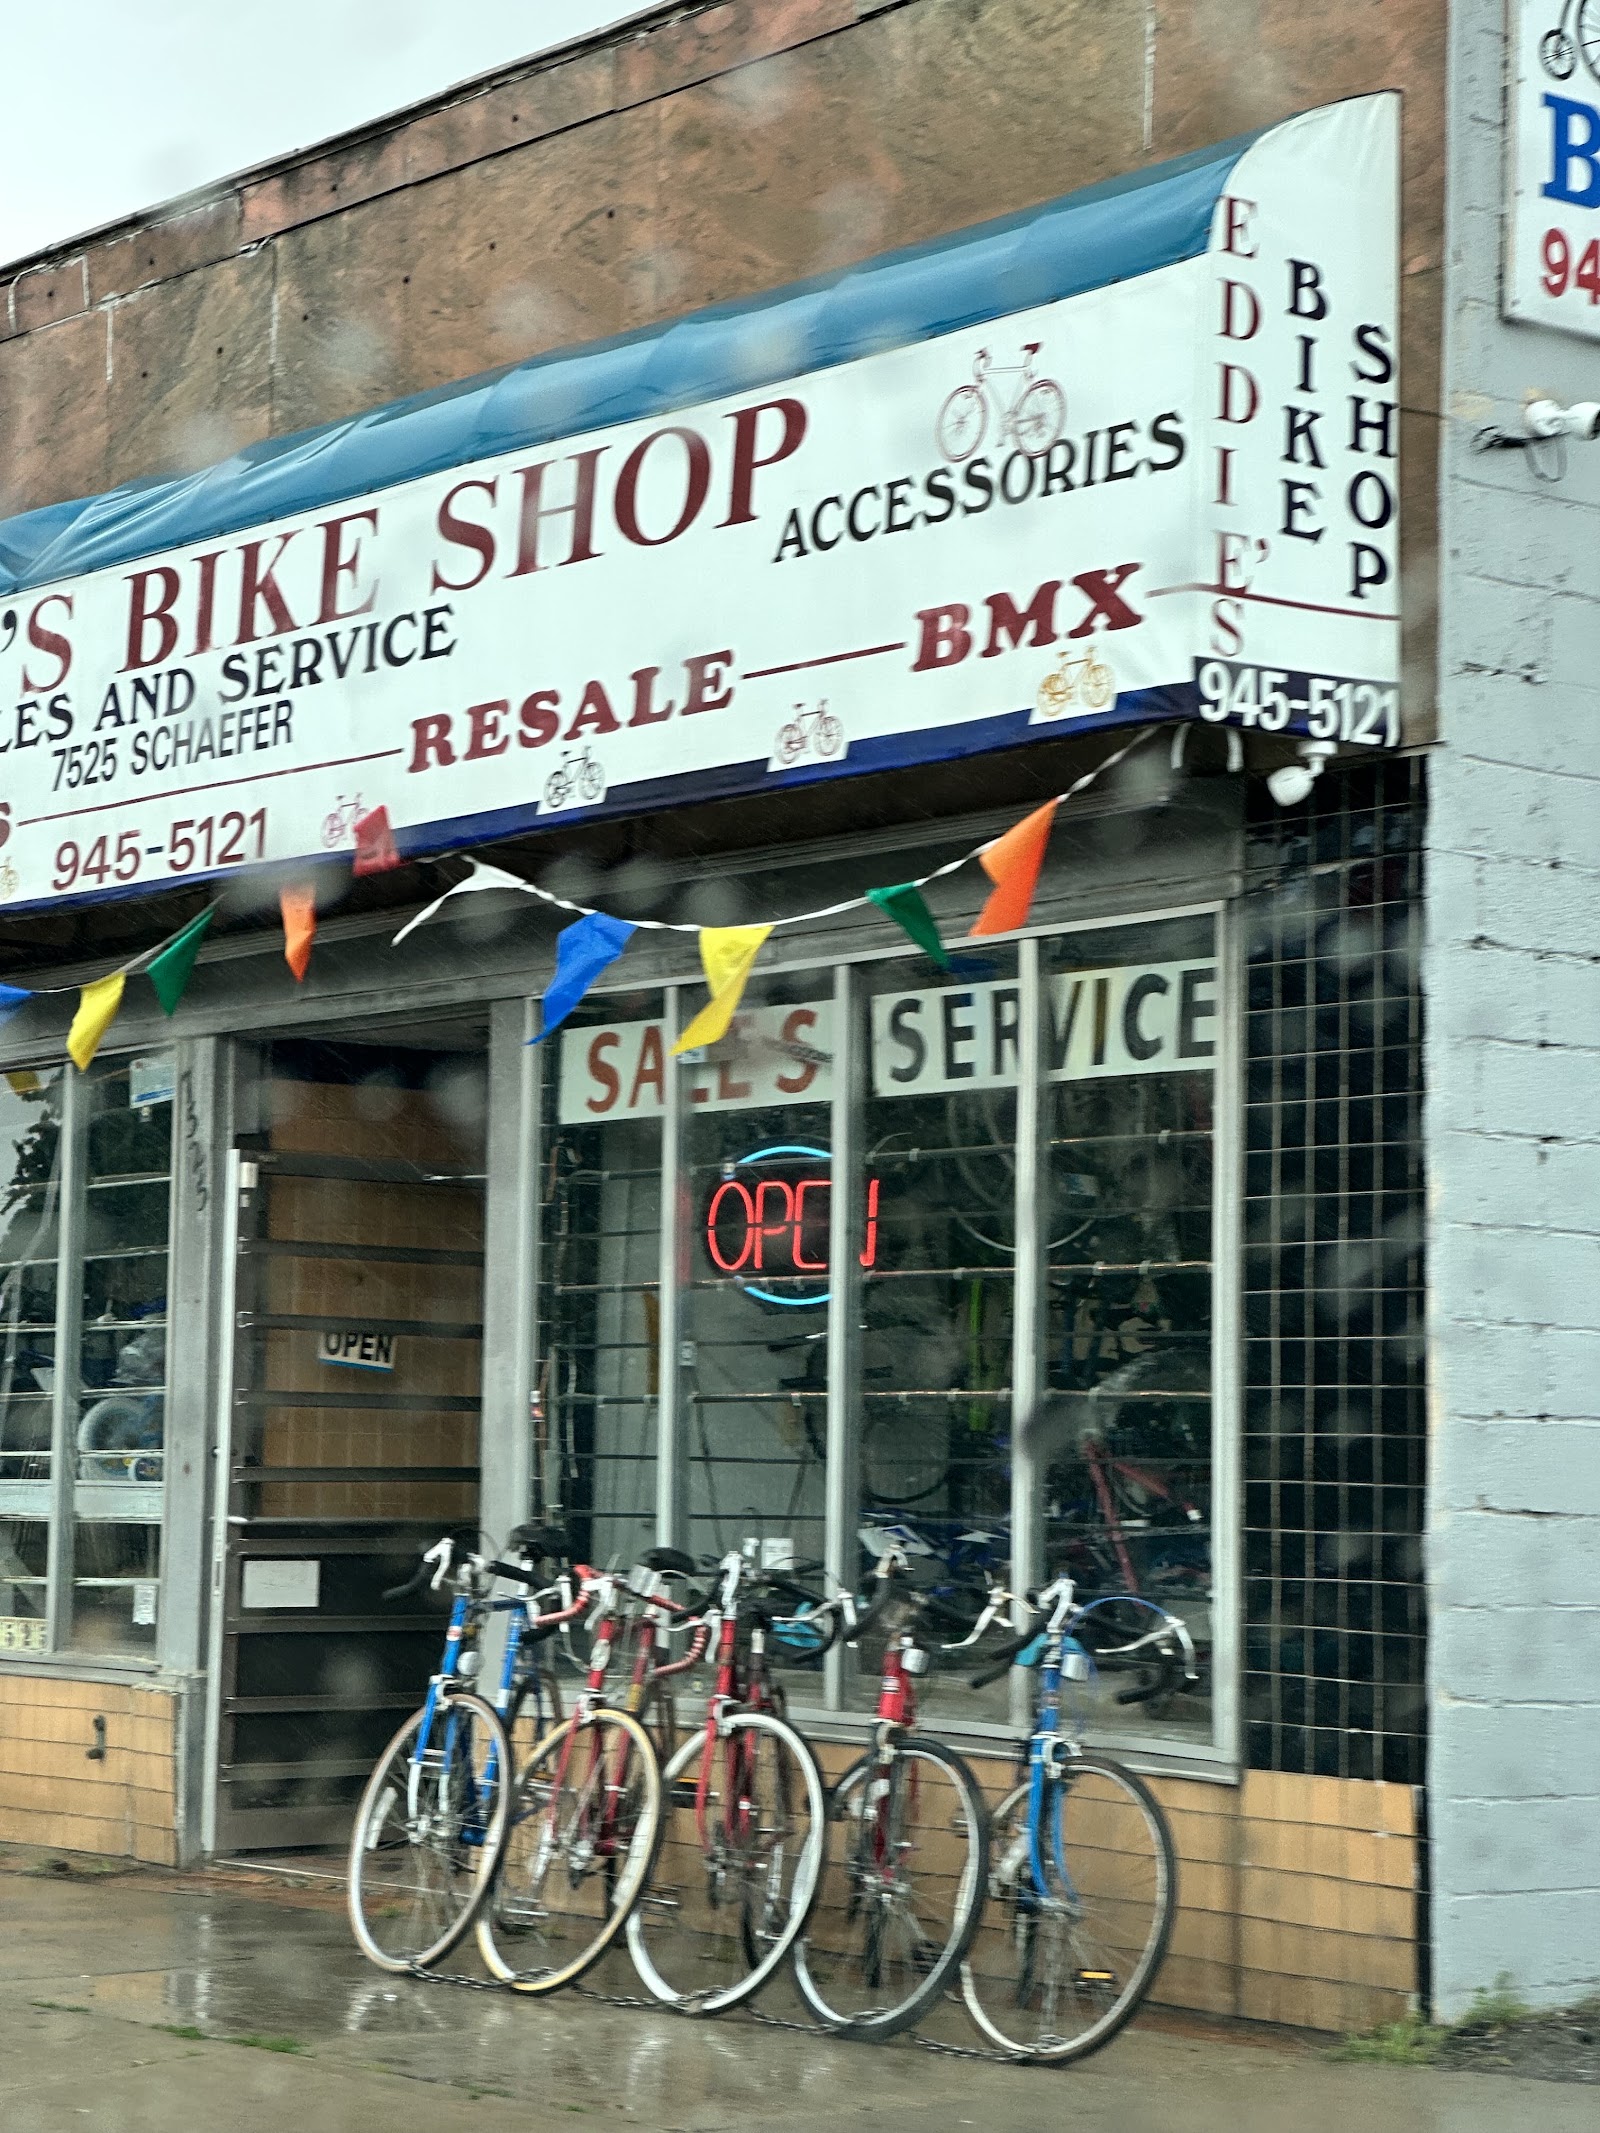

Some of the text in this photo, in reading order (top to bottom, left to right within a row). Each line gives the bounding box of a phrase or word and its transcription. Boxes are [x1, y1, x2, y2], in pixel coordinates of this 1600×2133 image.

[1279, 258, 1329, 544] BIKE
[1346, 323, 1399, 599] SHOP
[115, 507, 380, 674] BIKE
[430, 398, 809, 596] SHOP
[771, 411, 1187, 562] ACCESSORIES
[92, 667, 196, 732] AND
[218, 604, 457, 703] SERVICE
[910, 562, 1145, 672] BMX
[51, 699, 294, 791] 7525 SCHAEFER
[406, 649, 737, 774] RESALE
[1198, 661, 1399, 748] 945-5121
[52, 807, 267, 891] 945-5121
[585, 966, 1217, 1114] SAES SERVICE
[324, 1329, 393, 1363] OPEN
